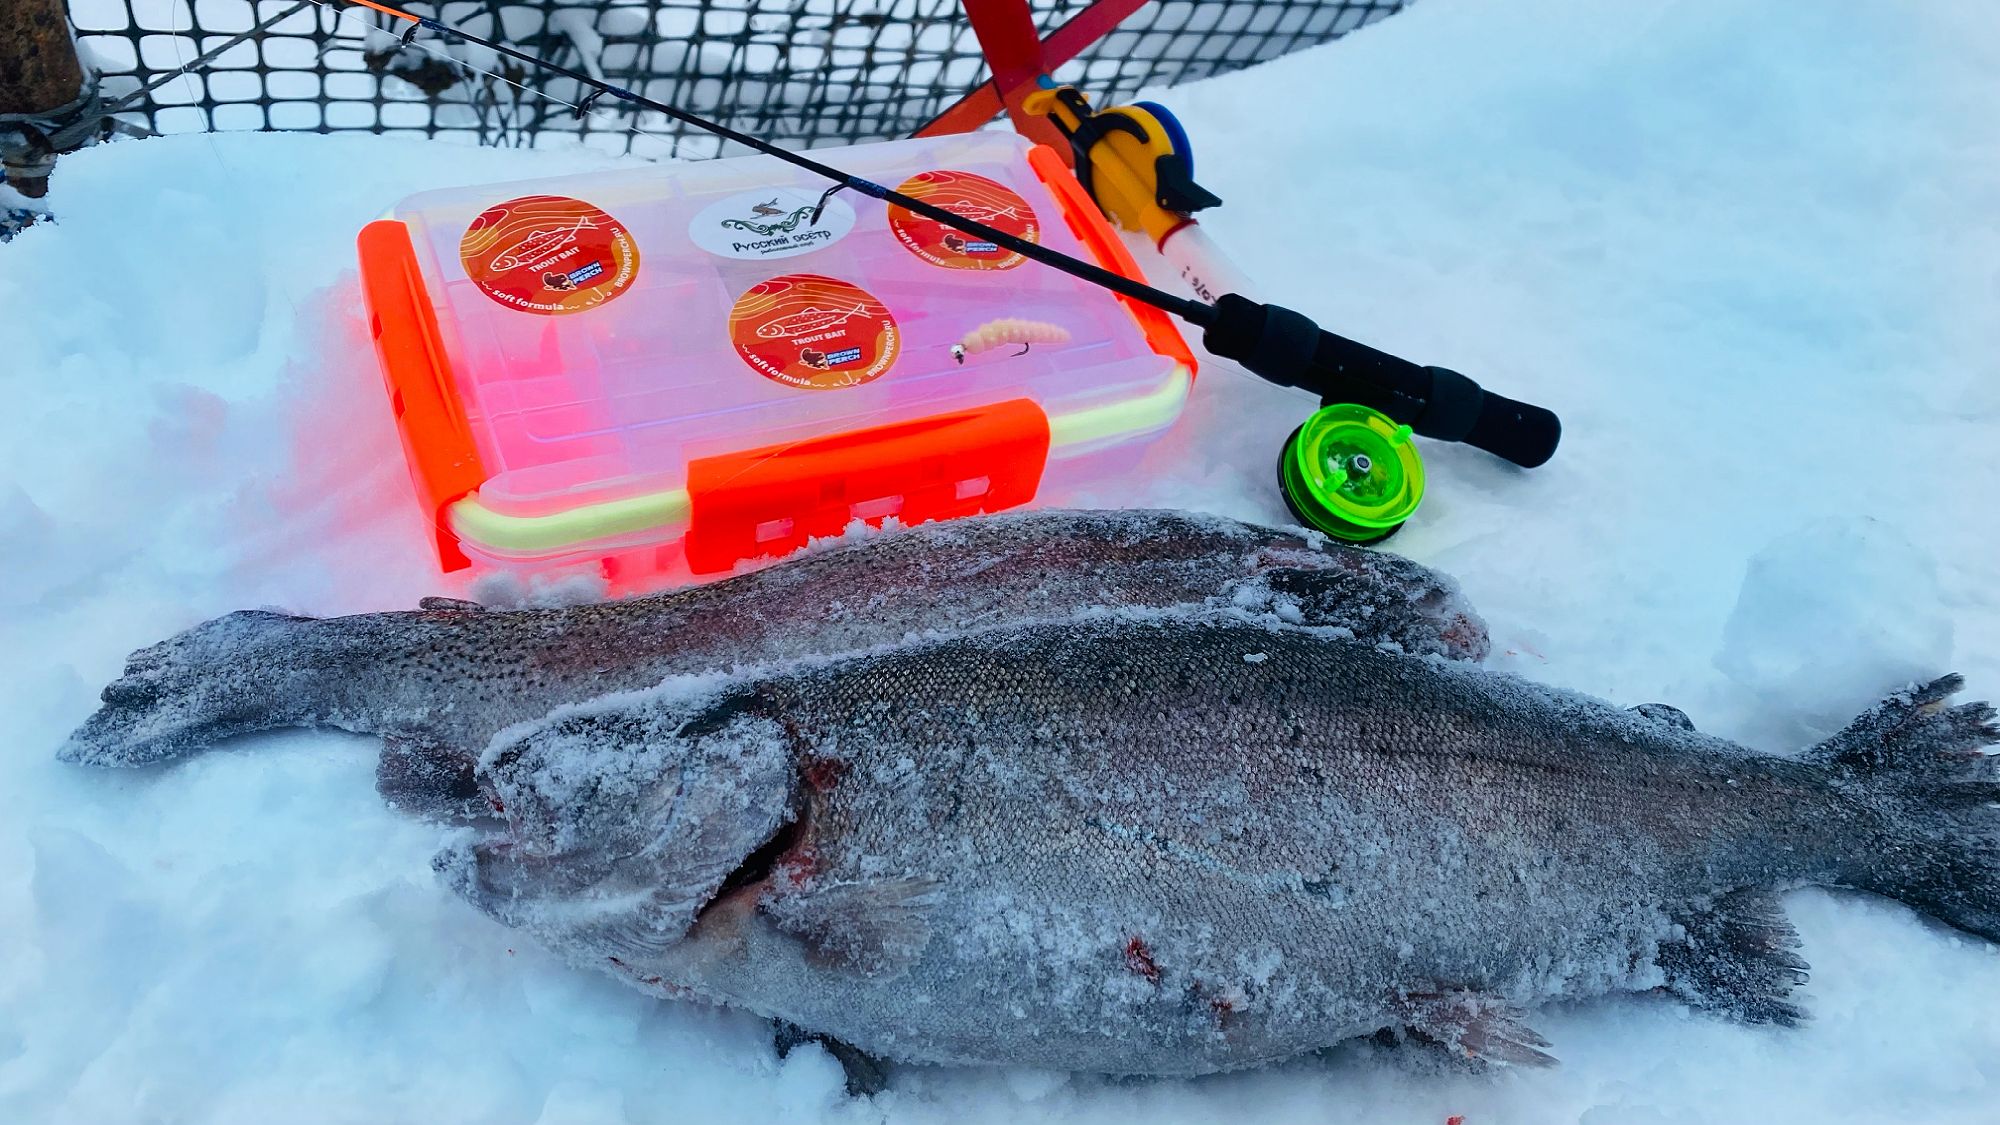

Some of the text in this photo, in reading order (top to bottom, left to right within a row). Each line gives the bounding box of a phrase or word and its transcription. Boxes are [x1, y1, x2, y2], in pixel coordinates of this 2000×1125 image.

[528, 246, 581, 273] TROUT BAIT
[568, 262, 601, 279] BROWN
[572, 267, 603, 285] PERCH
[492, 289, 565, 311] soft formula
[791, 329, 847, 346] TROUT BAIT
[826, 348, 860, 360] BROWN
[827, 353, 861, 366] PERCH
[749, 353, 812, 386] soft formula
